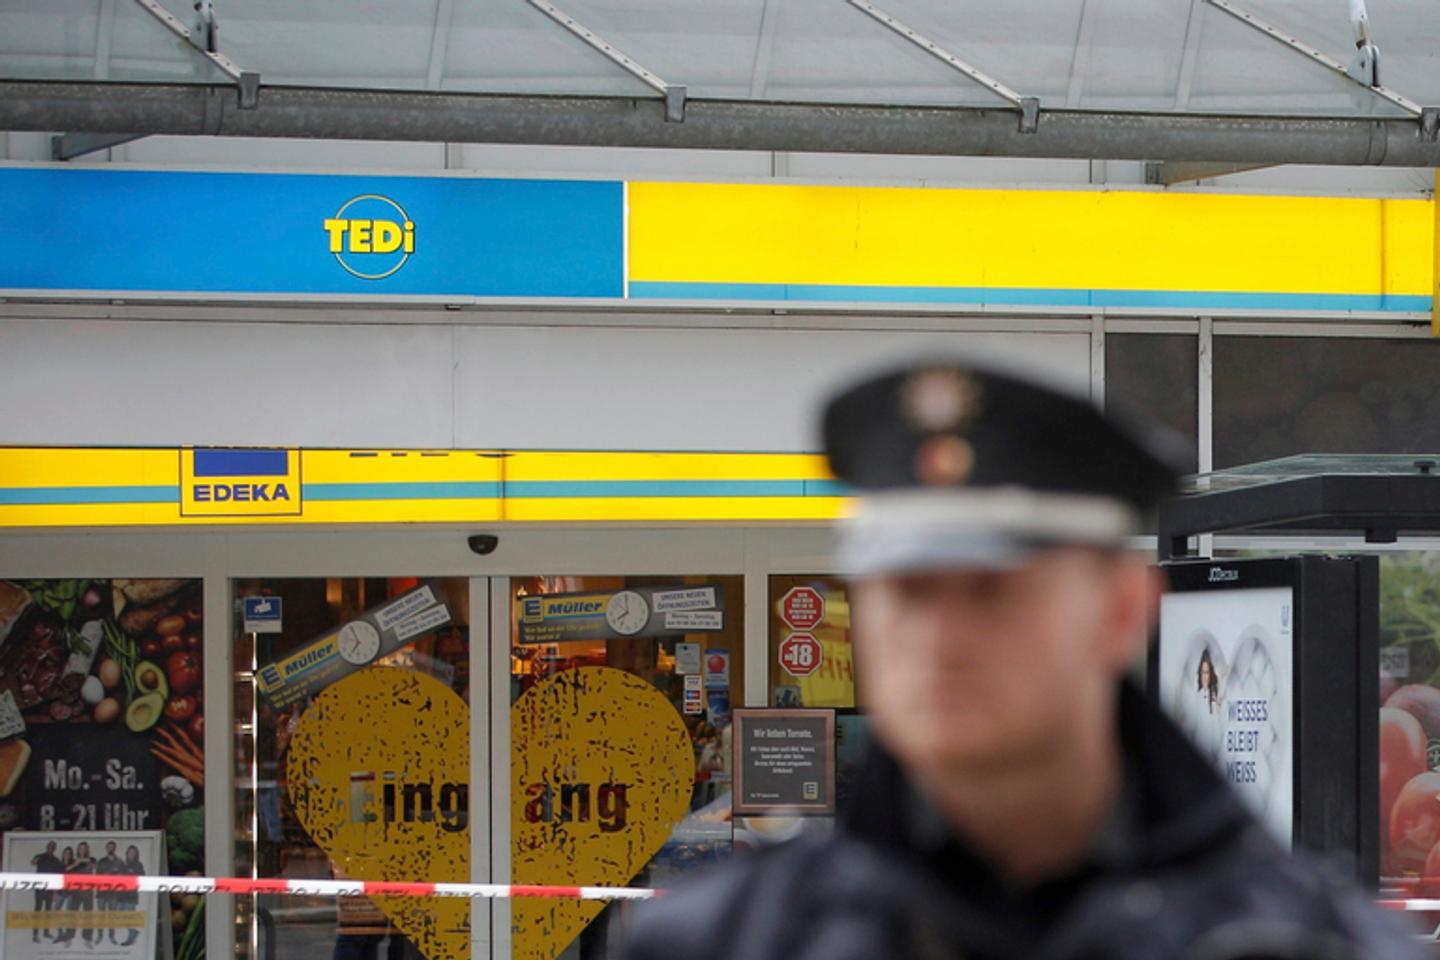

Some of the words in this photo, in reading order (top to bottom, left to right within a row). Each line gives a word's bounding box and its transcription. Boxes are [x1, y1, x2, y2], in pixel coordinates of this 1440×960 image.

[323, 219, 415, 253] TEDi
[193, 484, 290, 501] EDEKA
[548, 601, 602, 614] Müller
[789, 643, 813, 667] 18
[1227, 731, 1259, 752] BLEIBT
[105, 803, 149, 830] Uhr
